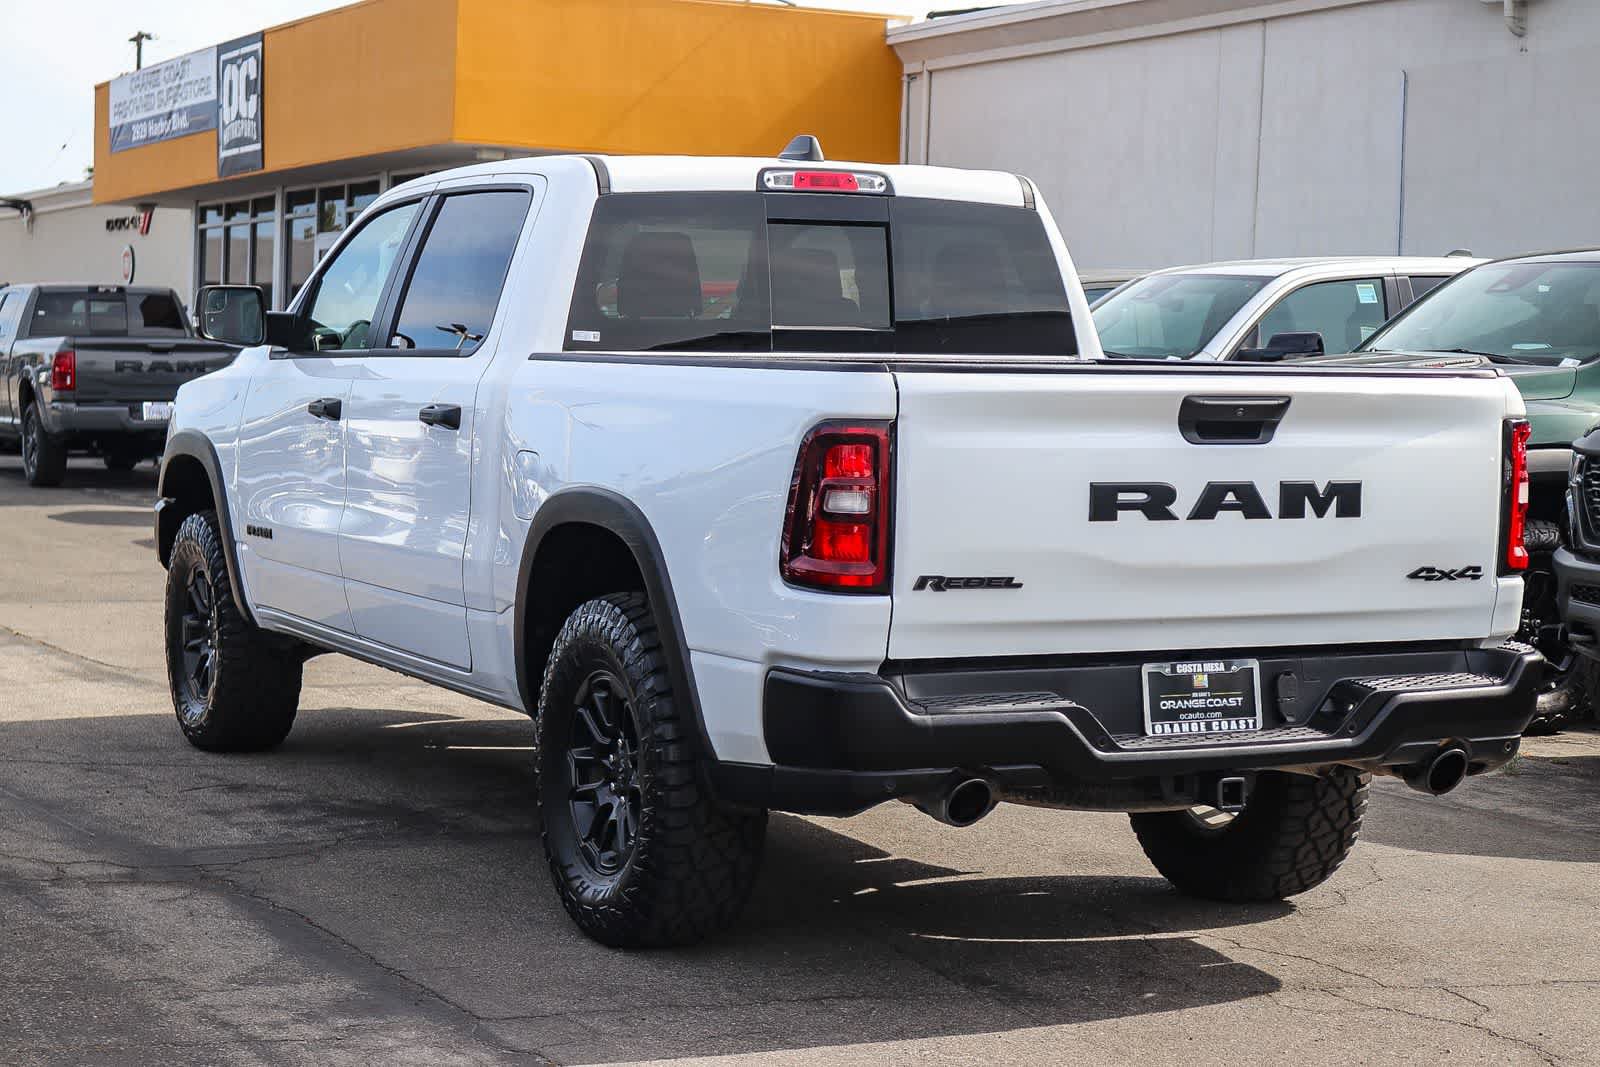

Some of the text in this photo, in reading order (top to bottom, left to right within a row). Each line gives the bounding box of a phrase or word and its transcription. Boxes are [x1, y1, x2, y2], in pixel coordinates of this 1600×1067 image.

[223, 56, 257, 125] OC
[114, 360, 206, 373] RAM
[1088, 480, 1363, 522] RAM
[1406, 565, 1484, 581] 4x4
[912, 575, 1024, 592] REBEL
[1176, 662, 1225, 674] COSTA MESA
[1160, 697, 1244, 710] ORANGE COAST
[1179, 711, 1223, 720] ocauto.com
[1154, 719, 1255, 734] ORANGE COAST
